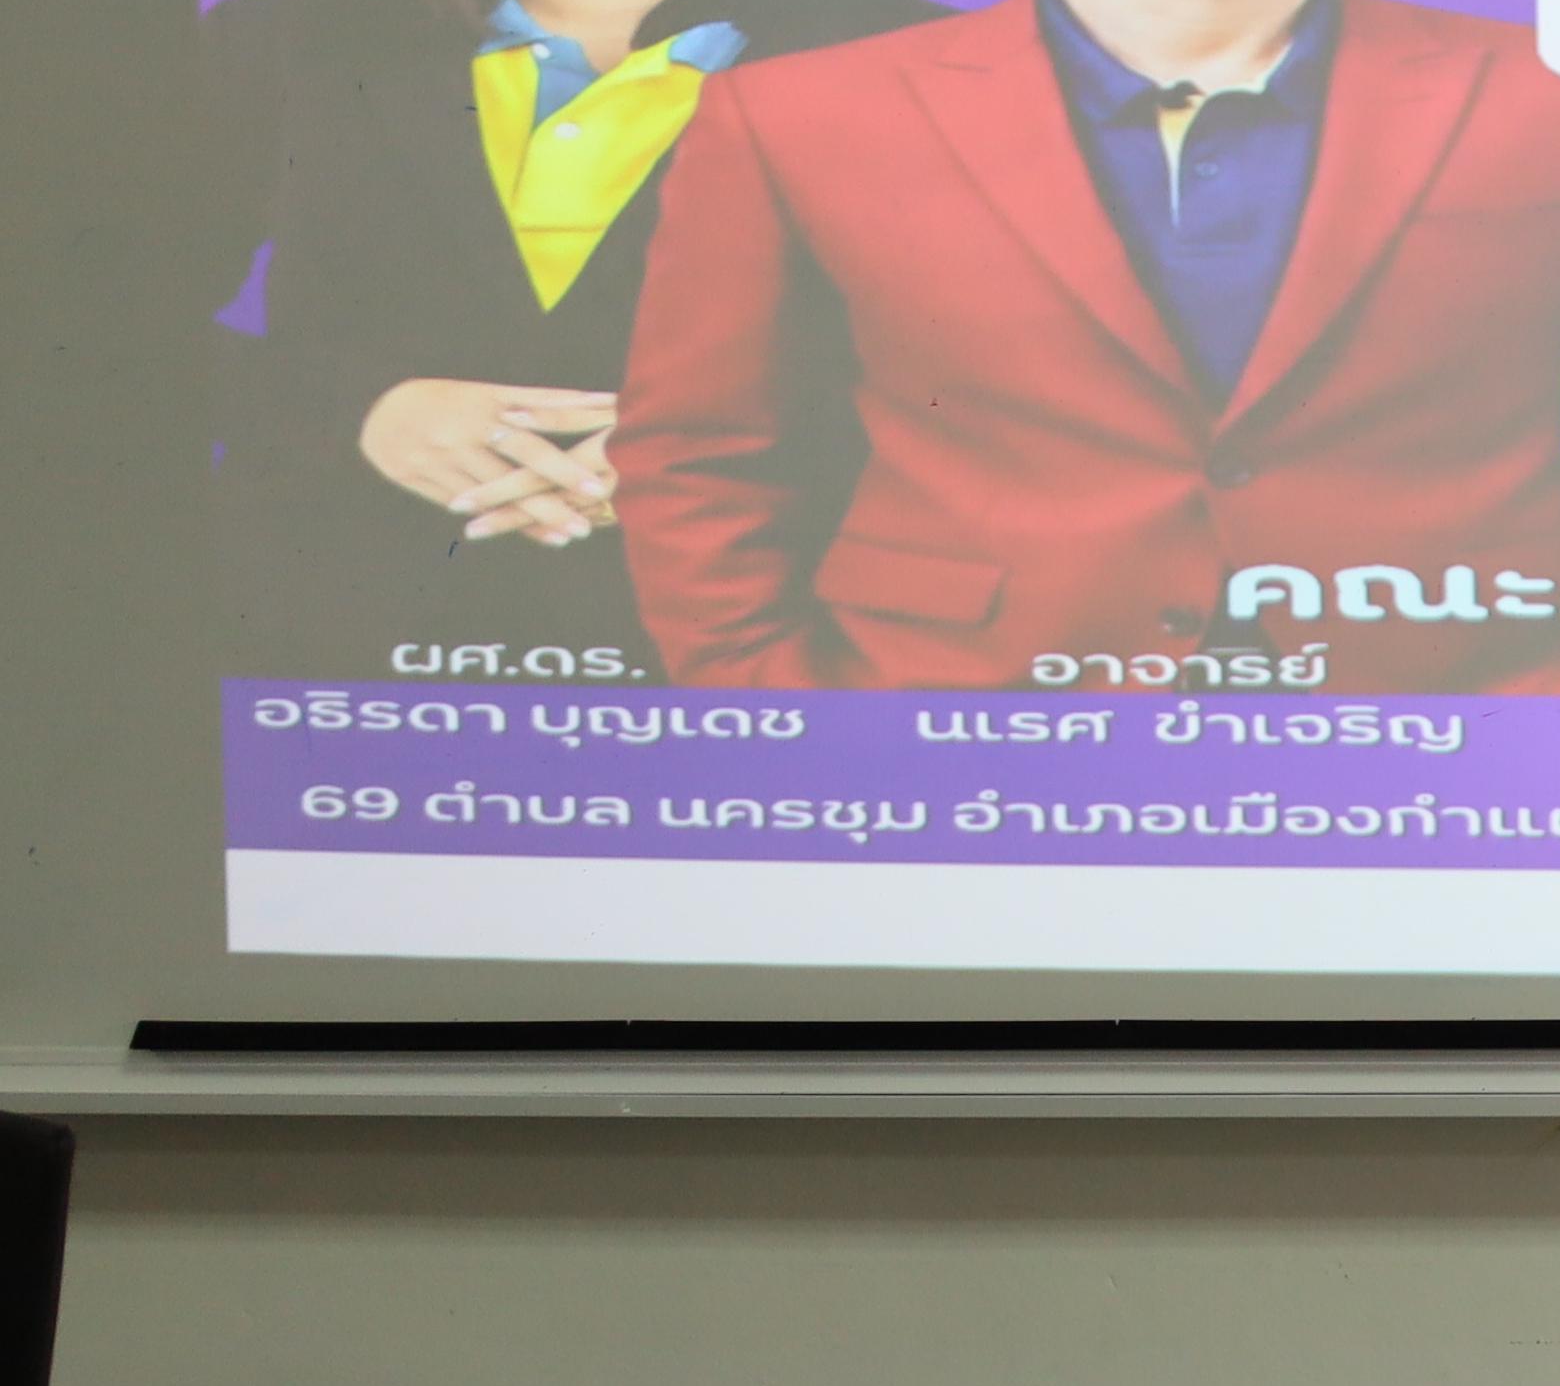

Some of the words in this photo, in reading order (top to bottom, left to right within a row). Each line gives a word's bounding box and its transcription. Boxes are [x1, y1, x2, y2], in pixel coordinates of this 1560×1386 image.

[391, 642, 646, 678] ผศ.ดร.
[1032, 642, 1329, 686] อาจารย์
[254, 691, 506, 732] อธิรดา
[531, 700, 806, 747] บุญเดช
[916, 707, 1115, 744] นเรศ
[1155, 699, 1464, 752] ขำเจริญ
[302, 785, 399, 820] 69
[424, 780, 629, 825] ตำบล
[658, 796, 925, 843] นครชุม
